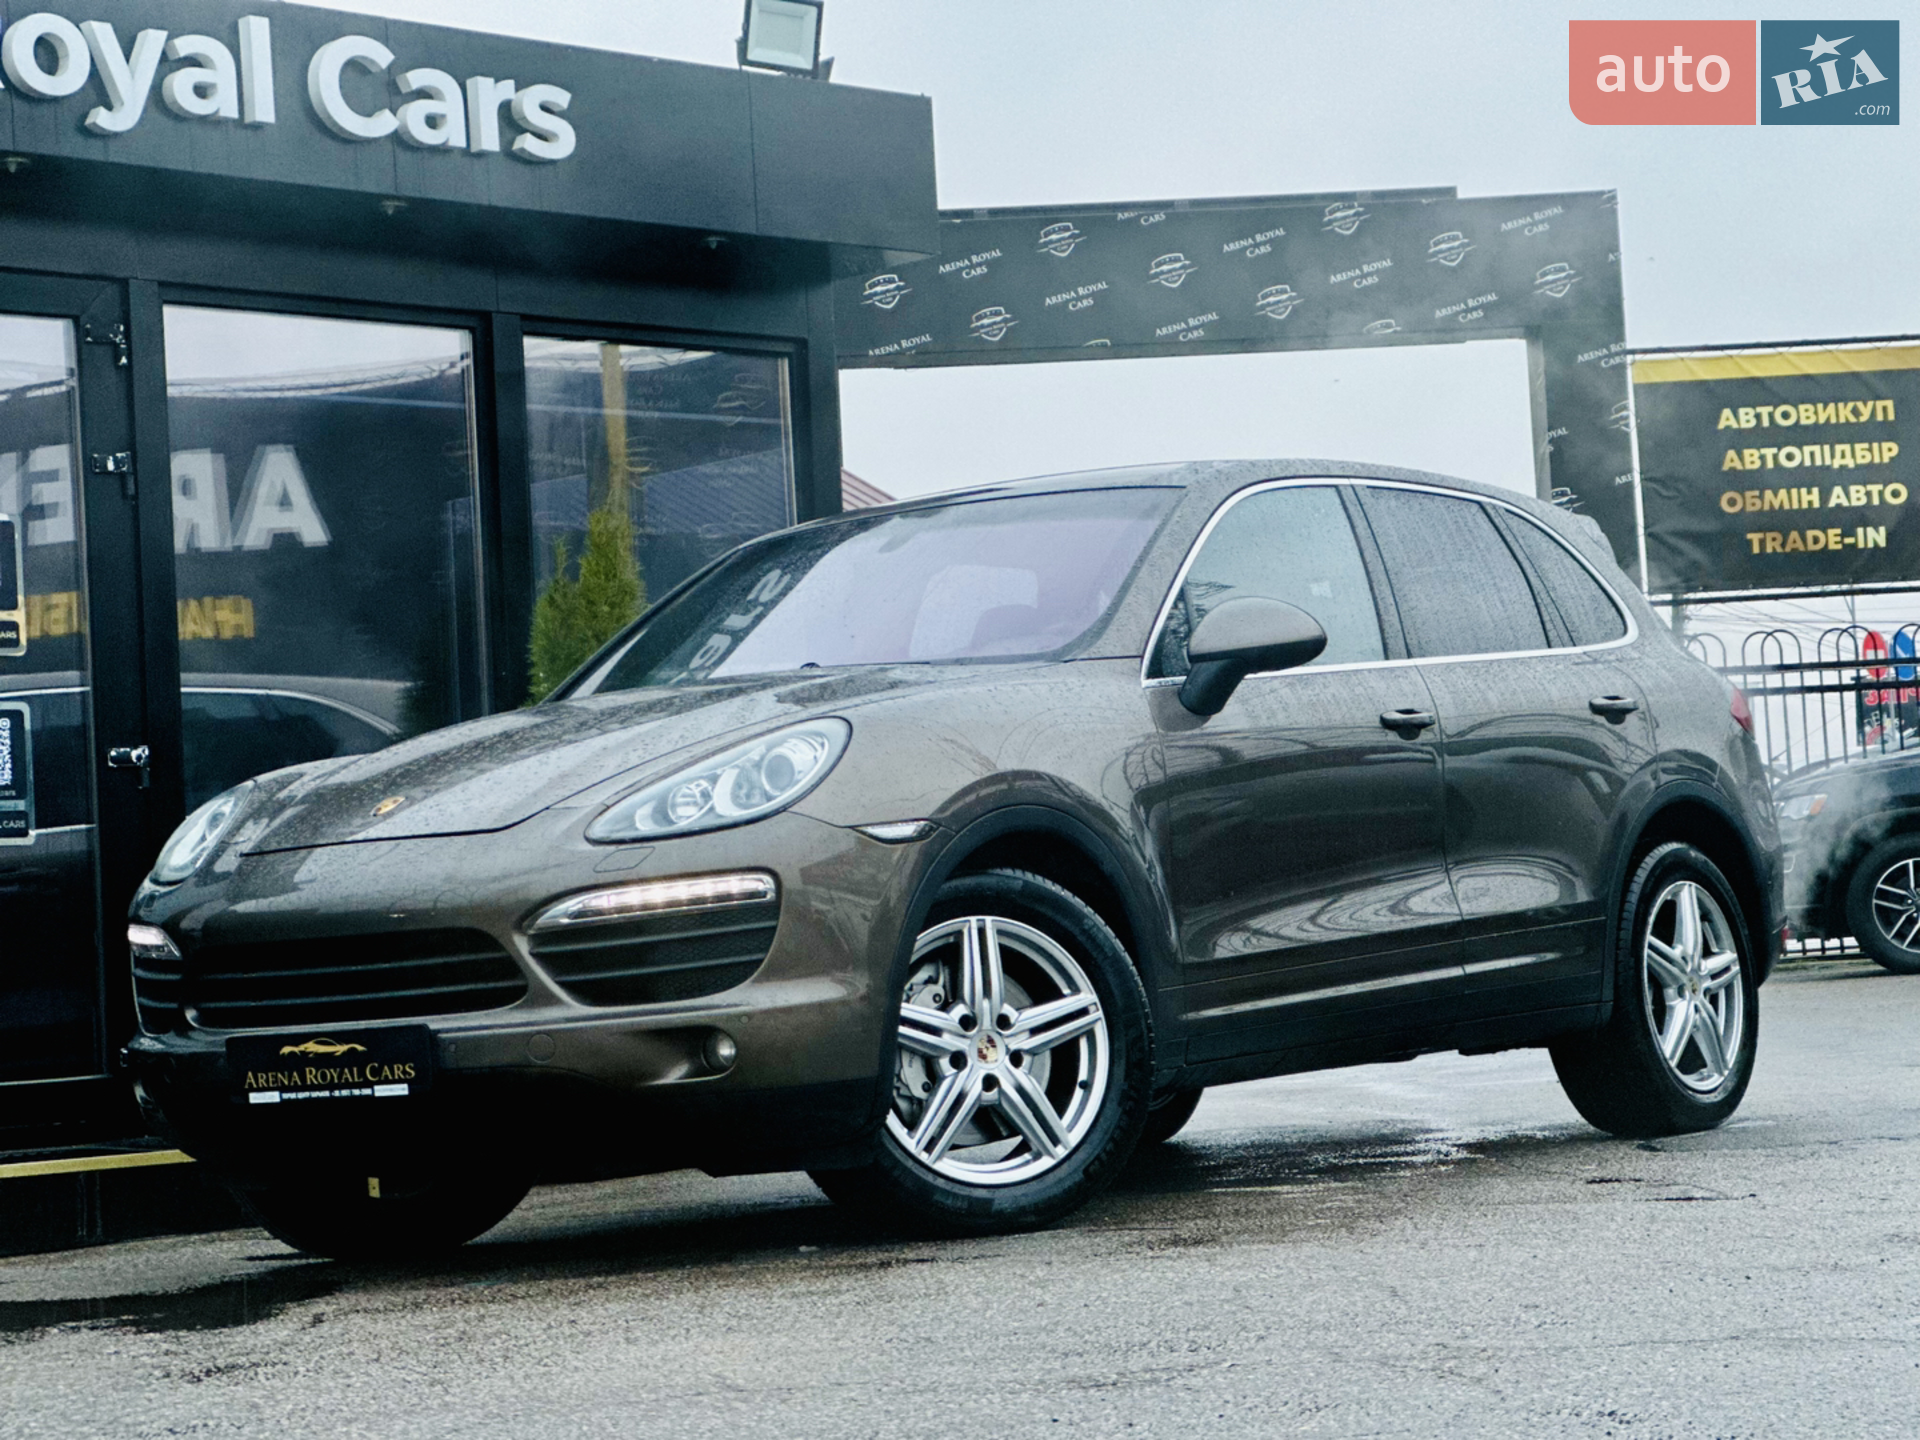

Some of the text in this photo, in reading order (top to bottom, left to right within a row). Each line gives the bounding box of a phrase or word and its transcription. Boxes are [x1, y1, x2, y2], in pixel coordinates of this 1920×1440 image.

[0, 13, 576, 161] oyal Cars
[1533, 205, 1565, 221] ROYAL
[1255, 227, 1287, 243] ROYAL
[1524, 222, 1550, 236] CARS
[971, 248, 1003, 264] ROYAL
[1246, 243, 1272, 257] CARS
[962, 265, 988, 278] CARS
[1362, 258, 1394, 274] ROYAL
[1077, 281, 1109, 296] ROYAL
[1353, 274, 1379, 288] CARS
[1068, 297, 1094, 311] CARS
[1467, 292, 1499, 308] ROYAL
[1188, 311, 1220, 328] ROYAL
[1458, 309, 1484, 323] CARS
[900, 333, 933, 349] ROYAL
[1179, 327, 1205, 341] CARS
[1717, 399, 1896, 430] АВТОВИКУП
[1721, 441, 1900, 472] АВТОПІДБІР
[1720, 482, 1908, 514] ОБМІН АВТО
[1746, 525, 1887, 555] TRADE-IN
[244, 1062, 416, 1089] ARENA ROYAL CARS
